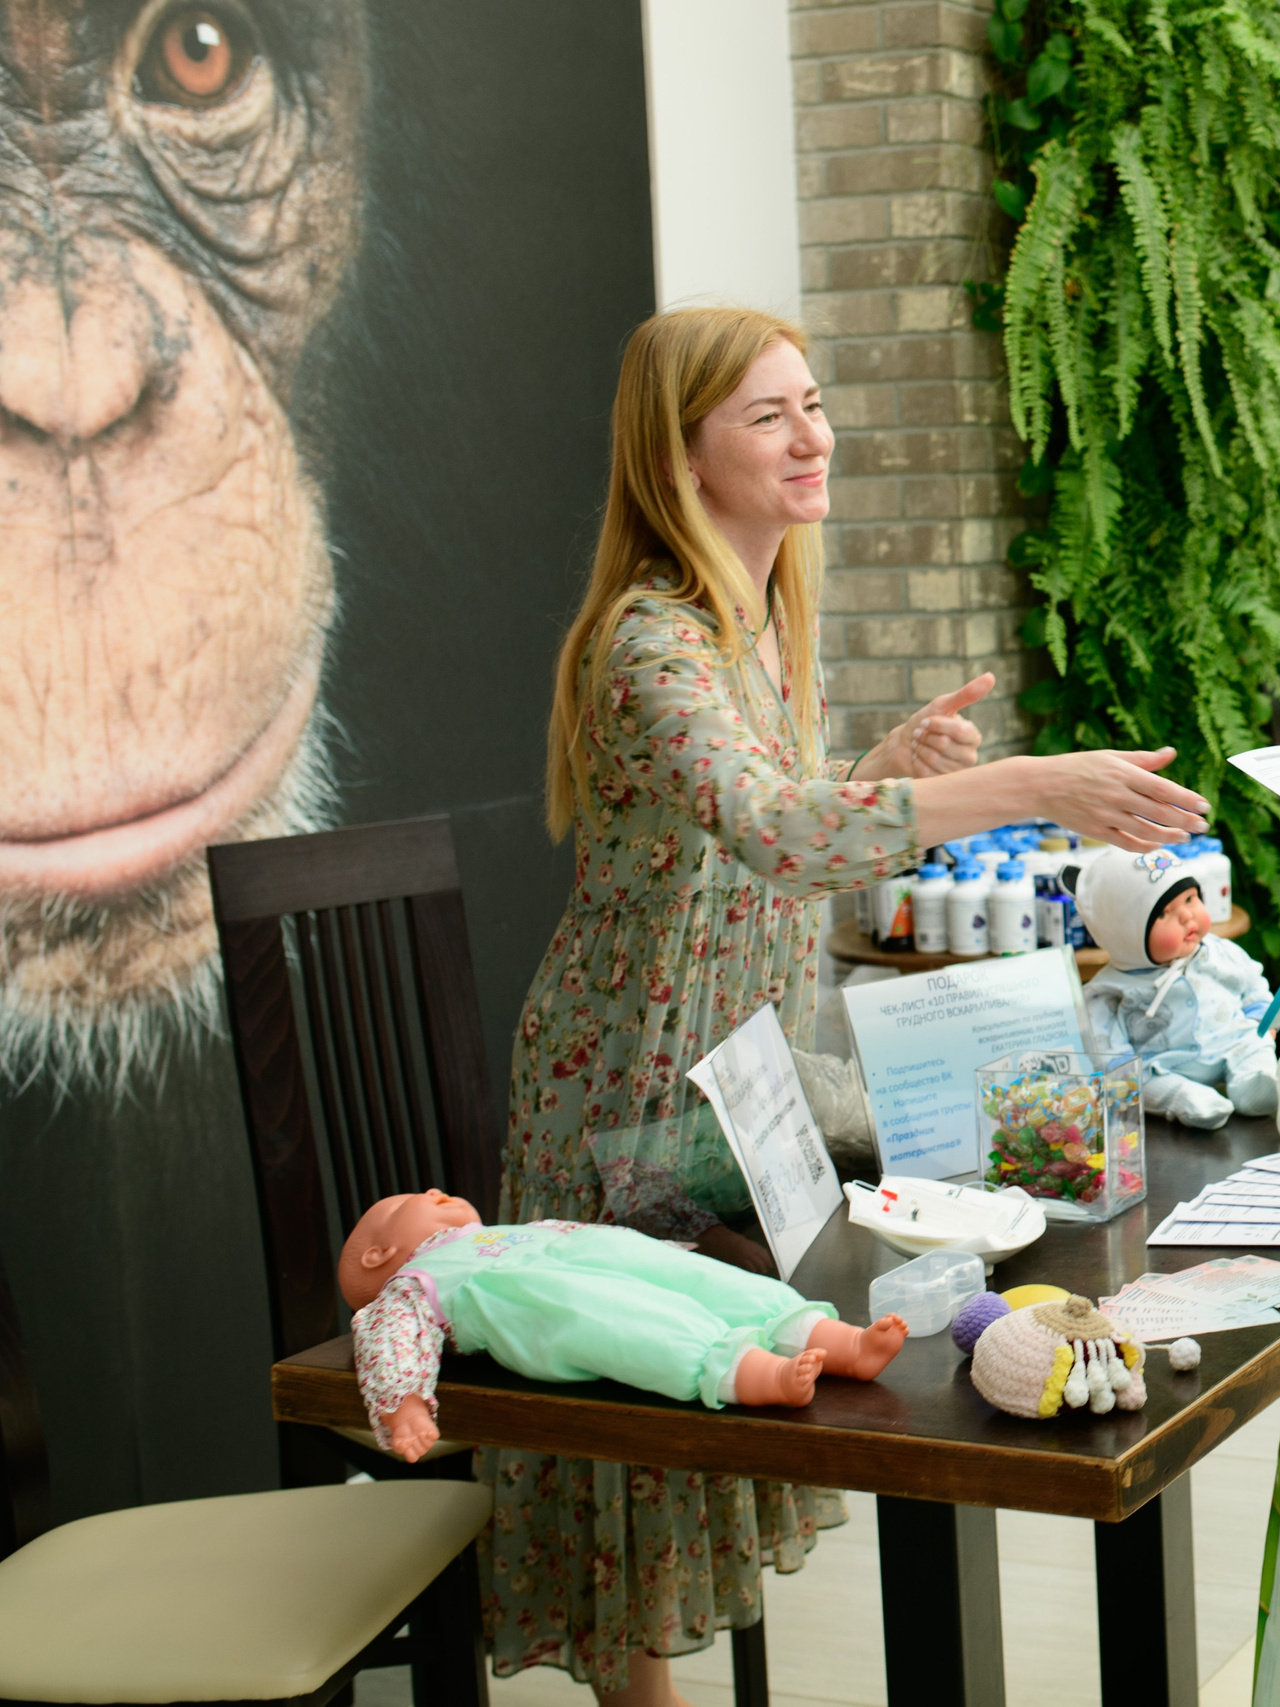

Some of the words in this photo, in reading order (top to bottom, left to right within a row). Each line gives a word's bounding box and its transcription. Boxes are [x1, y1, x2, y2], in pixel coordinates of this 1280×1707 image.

[926, 967, 989, 992] ПОДАРОК
[880, 998, 925, 1017] ЧЕК-ЛИСТ
[945, 987, 983, 1004] ПРАВИЛ
[896, 1009, 945, 1029] ГРУДНОГО
[991, 1038, 1032, 1054] ЕКАТЕРИНА
[886, 1058, 945, 1076] Подпишитесь
[876, 1087, 887, 1096] на
[888, 1075, 940, 1093] сообщество
[941, 1071, 953, 1082] ВК
[893, 1092, 938, 1108] Напишите
[889, 1108, 939, 1127] сообщения
